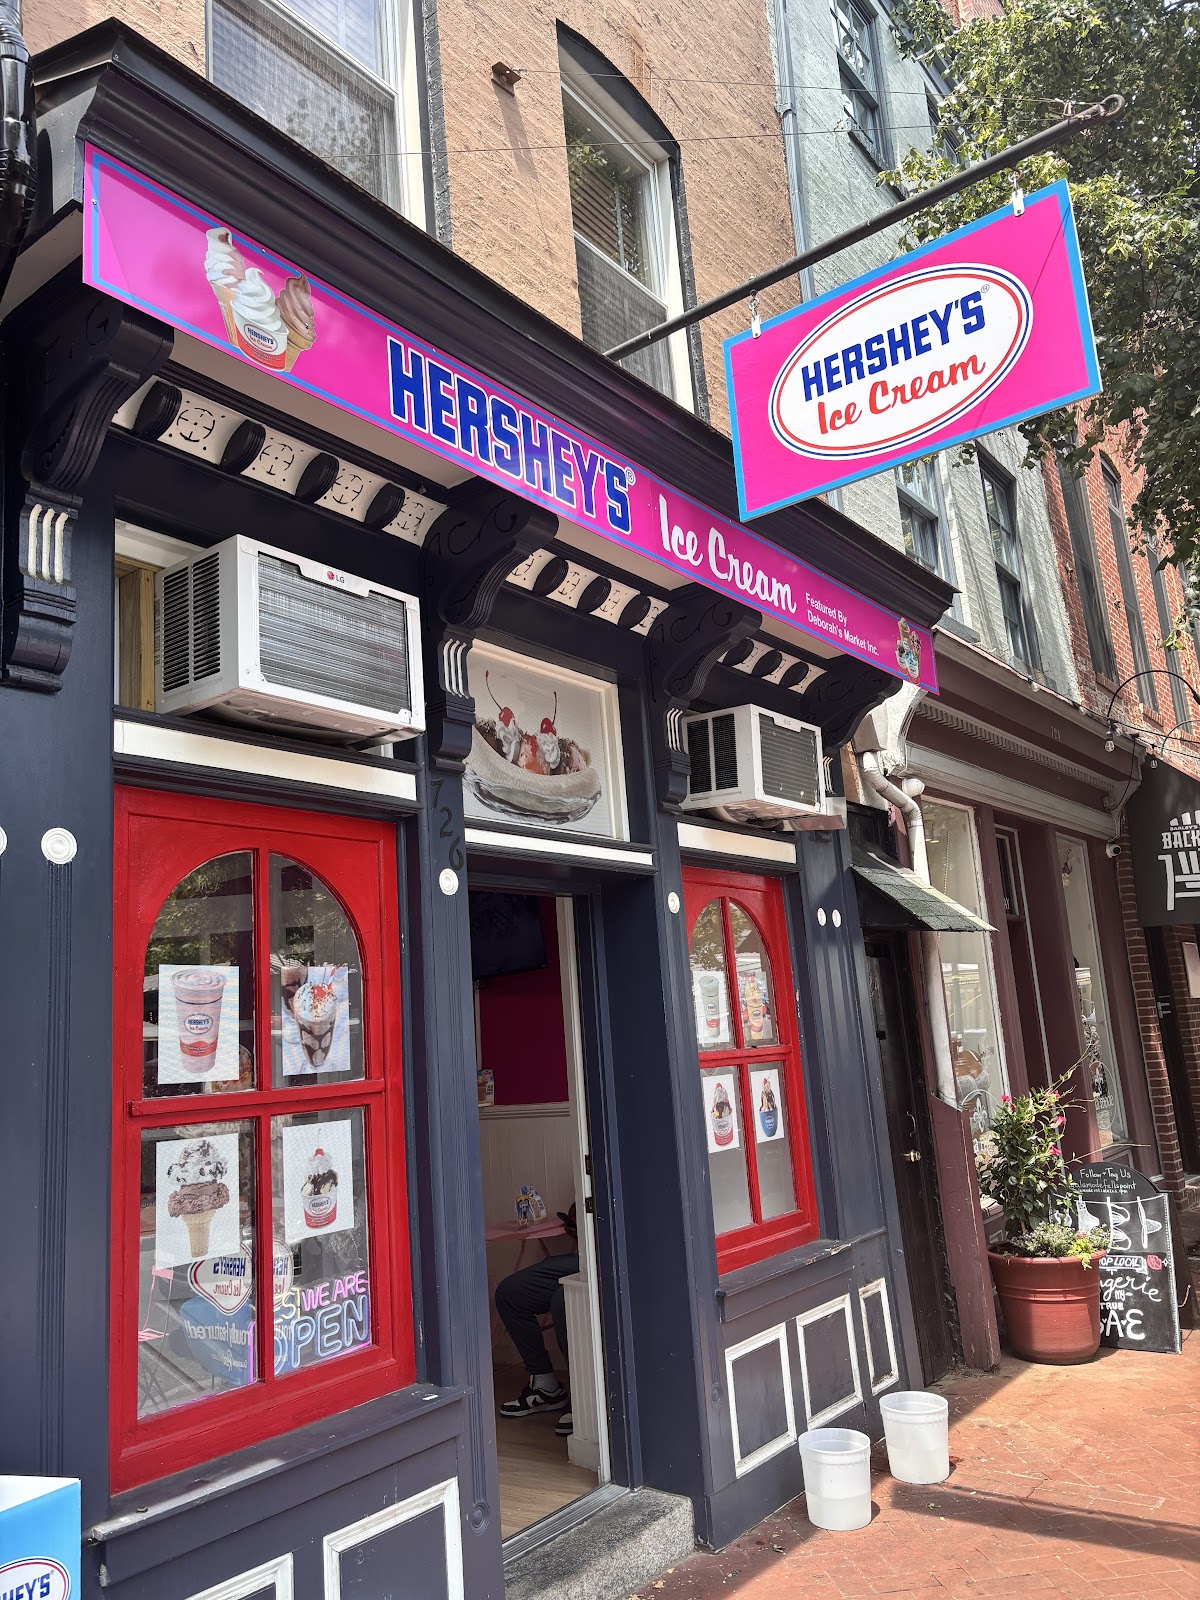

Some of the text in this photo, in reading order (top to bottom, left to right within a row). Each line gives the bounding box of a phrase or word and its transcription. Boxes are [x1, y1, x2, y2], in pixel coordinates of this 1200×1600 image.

[801, 291, 985, 401] HERSHEY'S
[817, 354, 985, 435] Ice Cream
[387, 335, 631, 534] HERSHEY'S
[659, 493, 797, 614] Ice Cream
[336, 574, 345, 583] LG
[805, 592, 848, 627] Featured By
[807, 610, 880, 656] Deborah's Market Inc.
[431, 779, 465, 871] 726
[1079, 1168, 1101, 1178] Follow
[1105, 1167, 1119, 1181] Tag
[1120, 1168, 1131, 1178] Us
[1100, 1257, 1140, 1267] OP LOCAL
[301, 1270, 368, 1312] WE ARE
